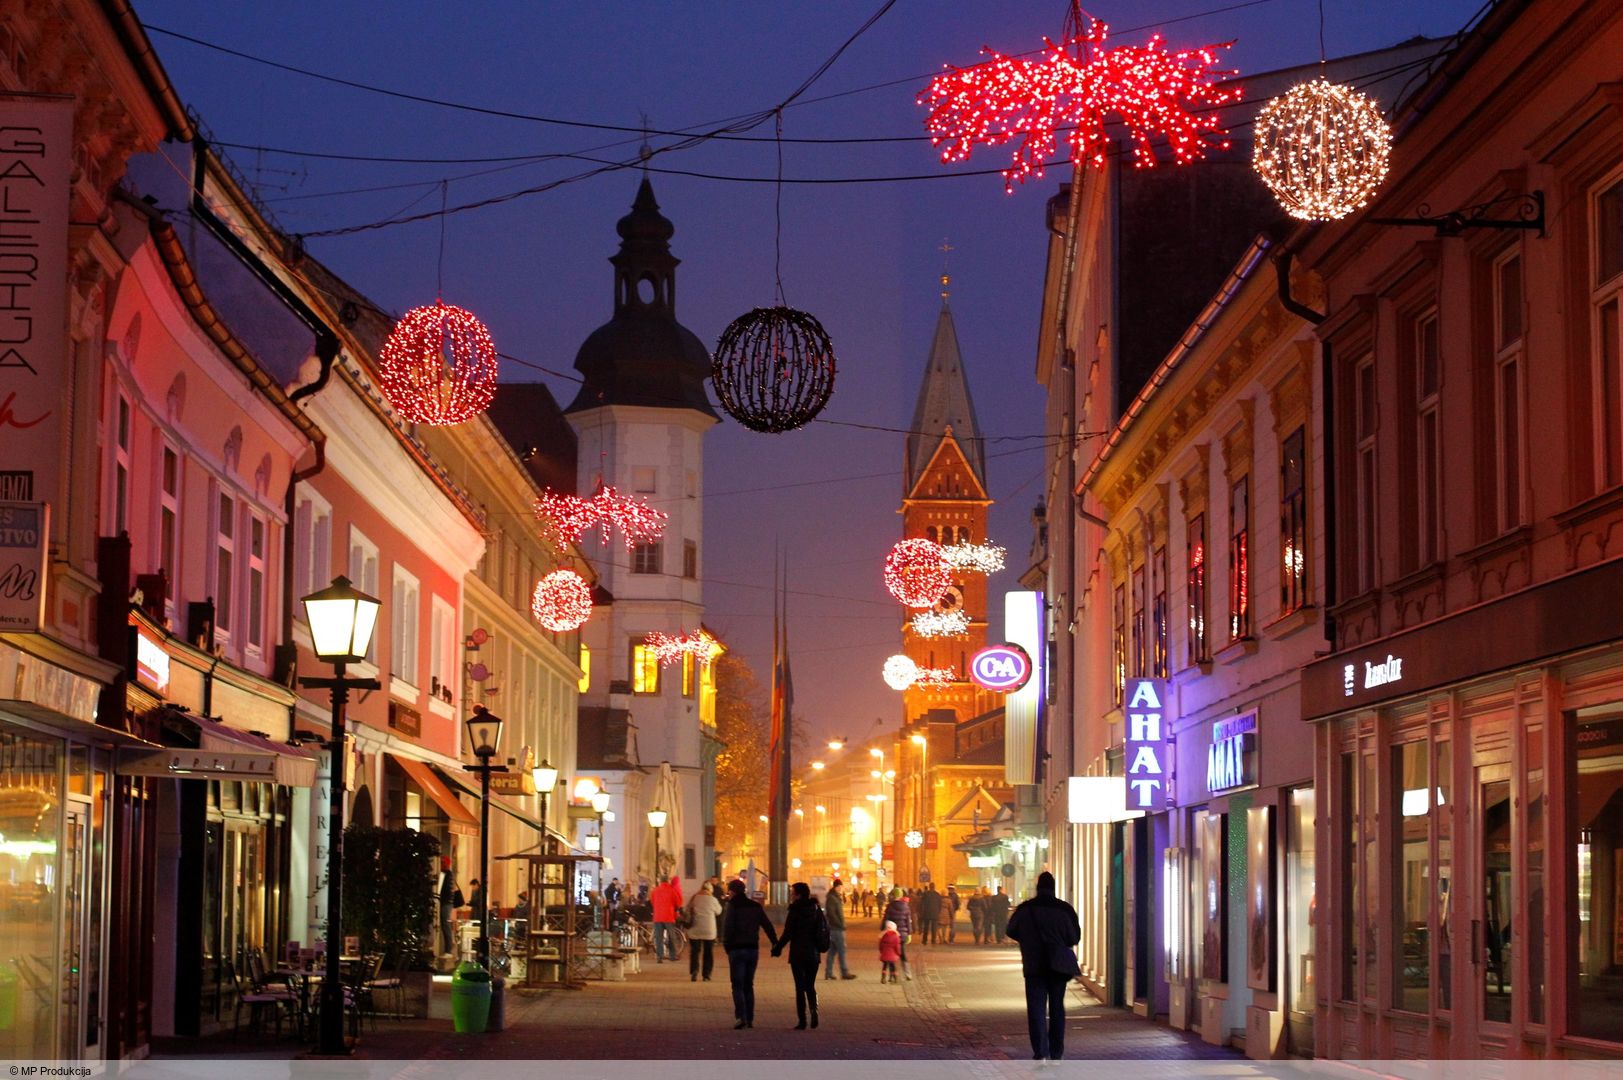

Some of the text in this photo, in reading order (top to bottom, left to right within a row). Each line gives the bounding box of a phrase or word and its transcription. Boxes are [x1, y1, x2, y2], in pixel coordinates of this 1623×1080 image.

[0, 126, 45, 376] GALERIJA
[980, 656, 1018, 678] C&A
[172, 757, 275, 771] OPTIKA
[1128, 681, 1162, 807] AHAT
[313, 755, 330, 941] MARELL
